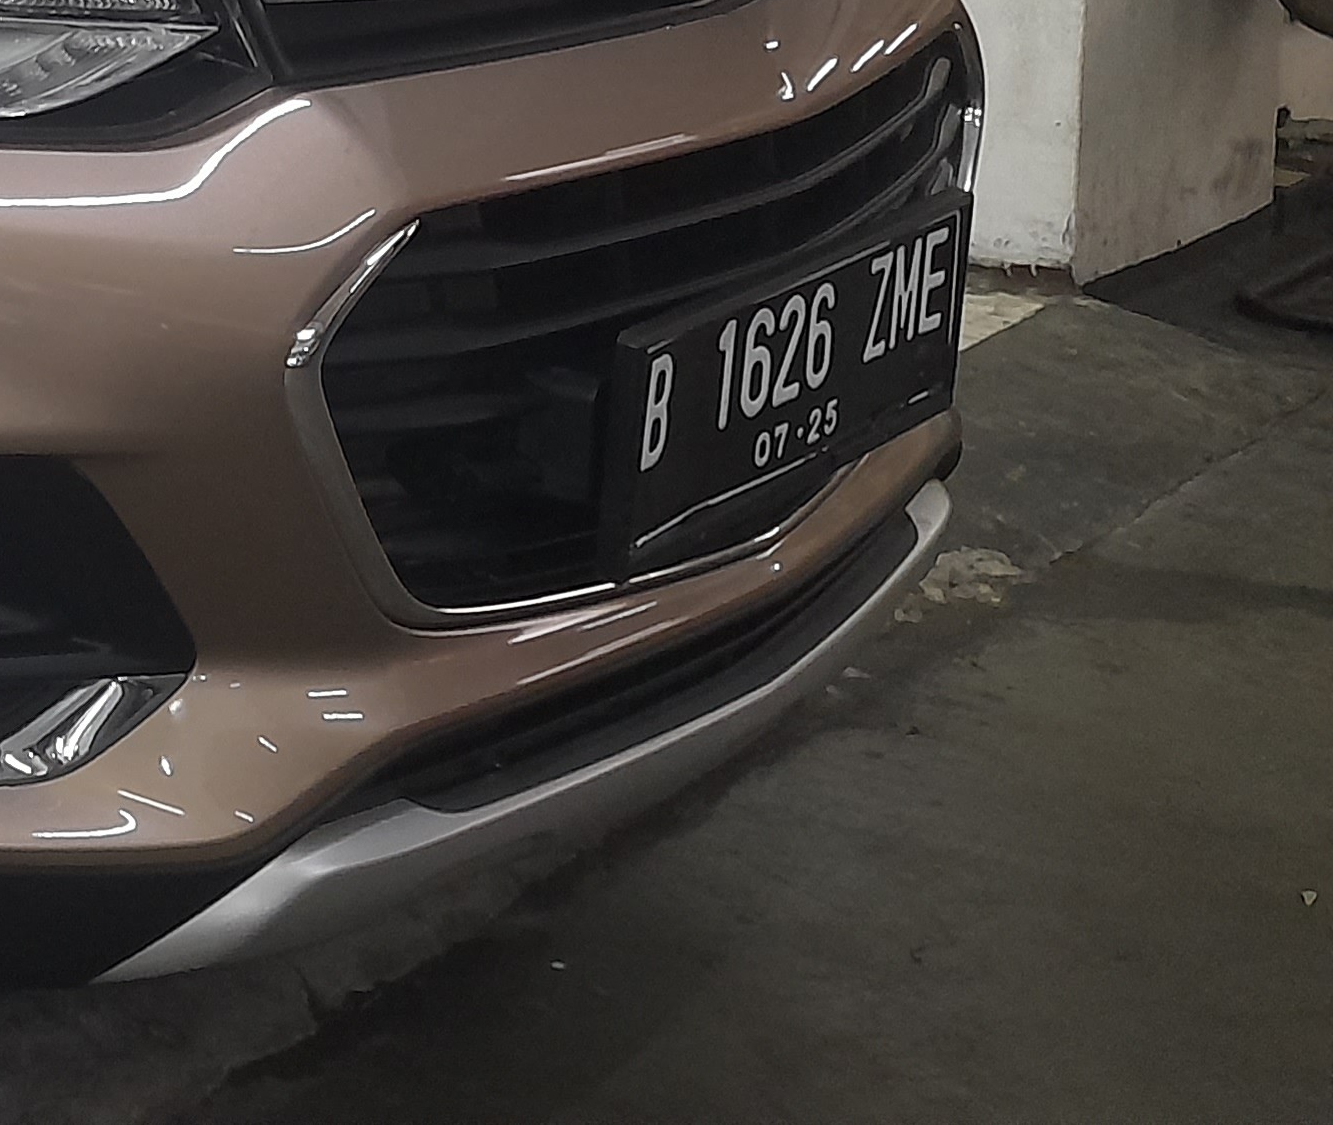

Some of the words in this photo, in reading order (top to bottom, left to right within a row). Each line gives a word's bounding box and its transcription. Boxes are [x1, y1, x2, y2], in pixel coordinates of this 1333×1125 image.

[639, 353, 674, 473] B
[717, 282, 836, 431] 1626
[862, 226, 950, 364] ZME
